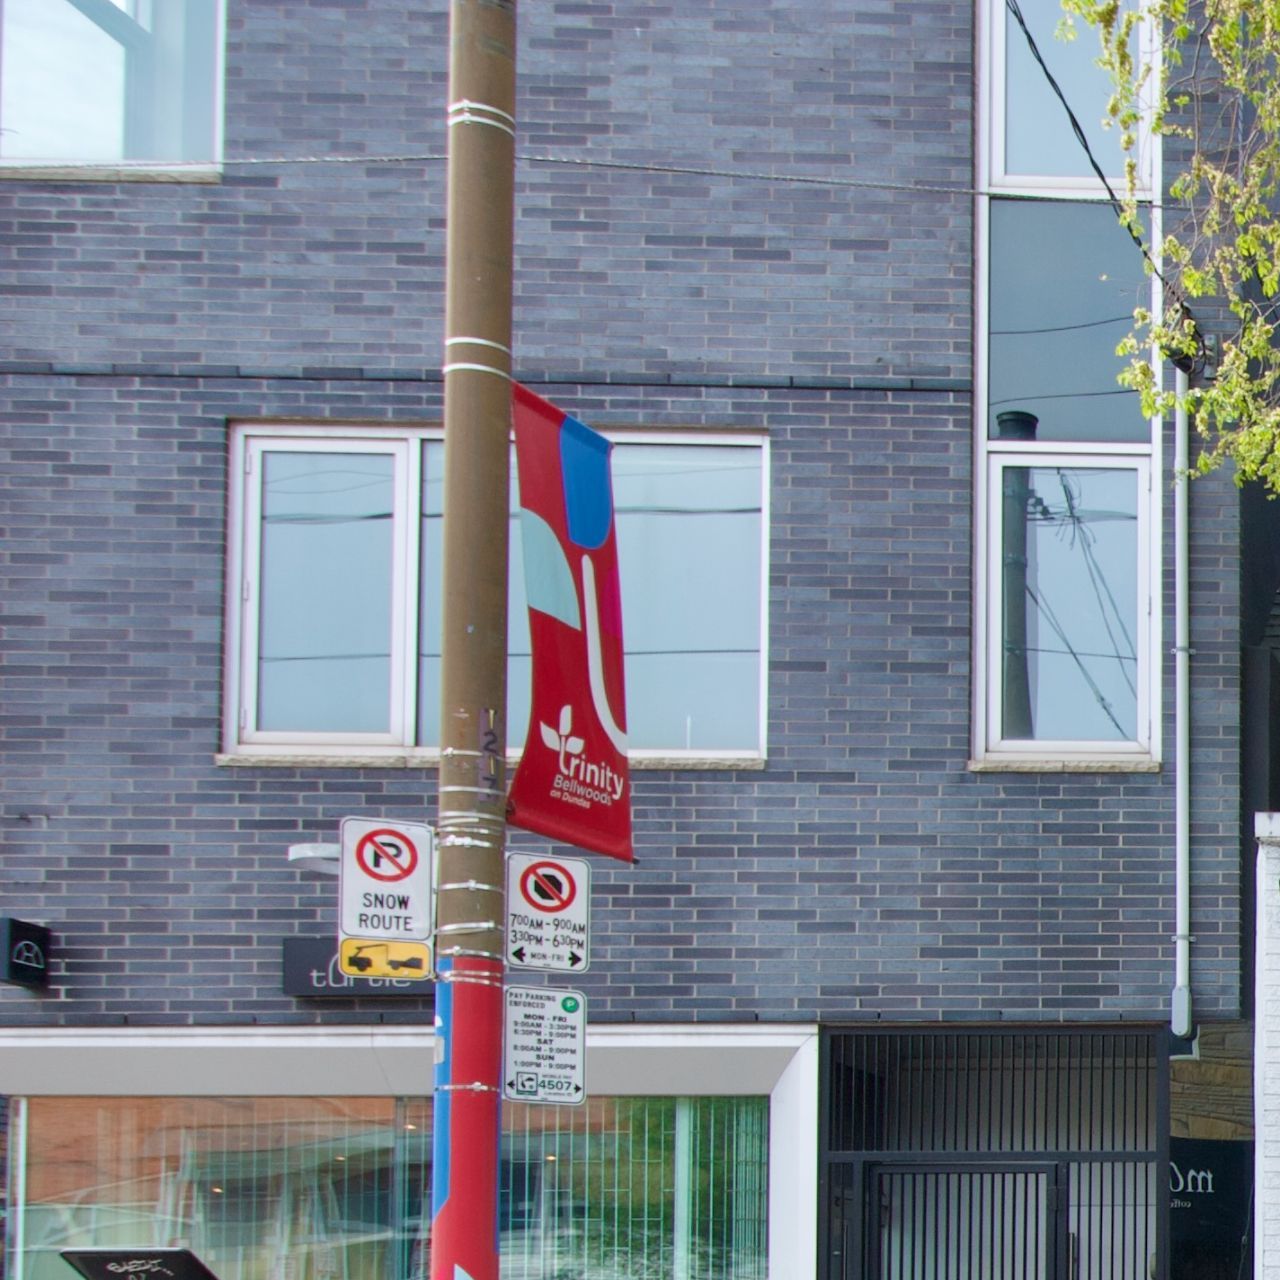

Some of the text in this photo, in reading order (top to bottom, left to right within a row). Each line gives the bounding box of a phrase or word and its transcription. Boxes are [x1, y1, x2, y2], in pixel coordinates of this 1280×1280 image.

[553, 774, 612, 806] Bellwoods
[550, 790, 591, 809] on Dundas
[363, 893, 410, 910] SNOW
[359, 914, 413, 931] ROUTE
[509, 1000, 546, 1009] ENFORCED
[525, 993, 556, 1002] PARKING
[523, 1013, 545, 1021] MON
[538, 1080, 572, 1091] 4507
